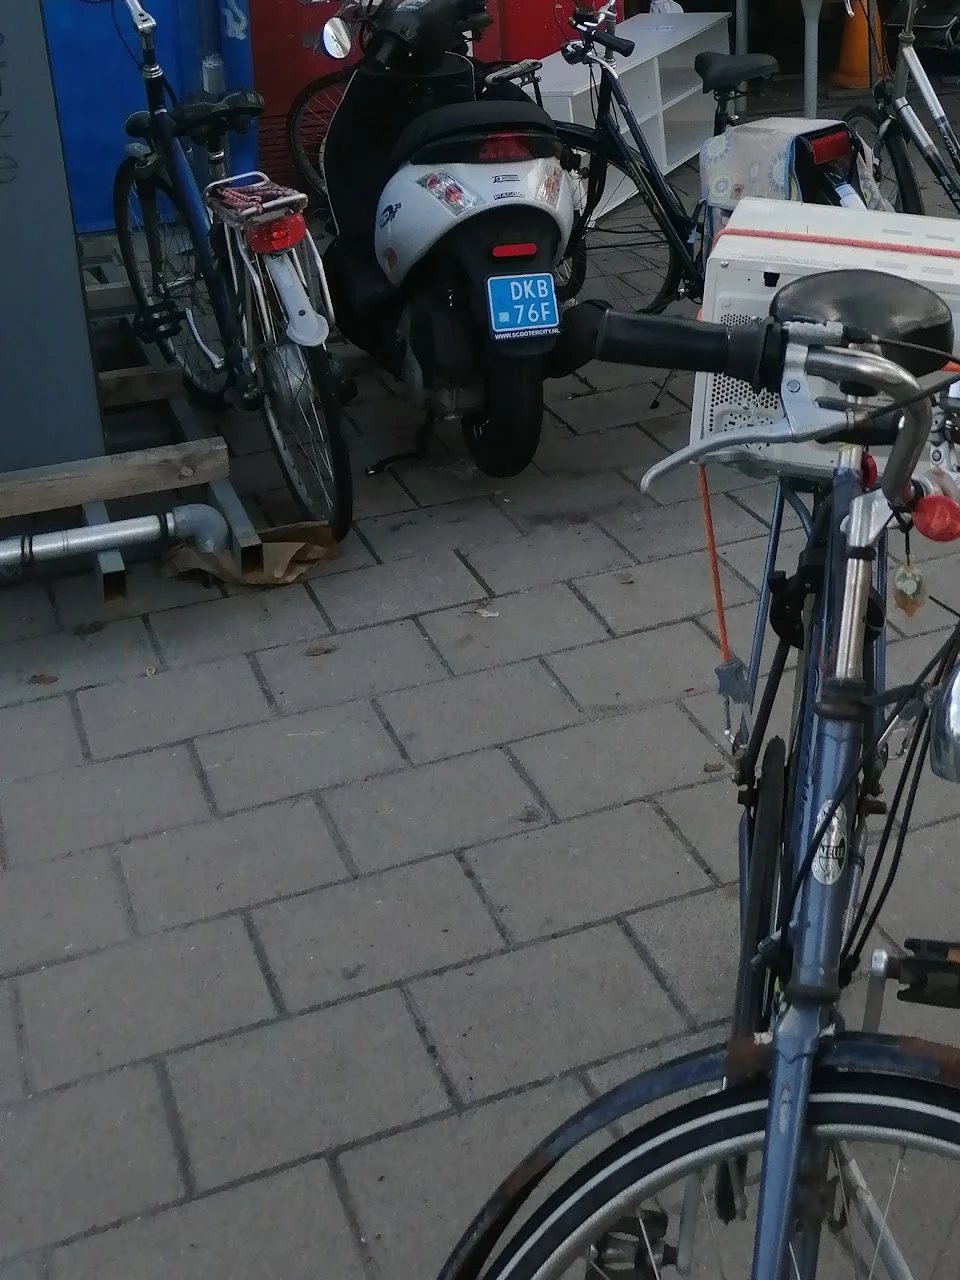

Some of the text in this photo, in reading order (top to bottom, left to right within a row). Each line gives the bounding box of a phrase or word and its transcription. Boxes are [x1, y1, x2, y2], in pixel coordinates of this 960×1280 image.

[510, 279, 549, 301] DKB
[513, 301, 551, 324] 76F
[494, 328, 561, 340] WWW.SCOOTERCITY.NL
